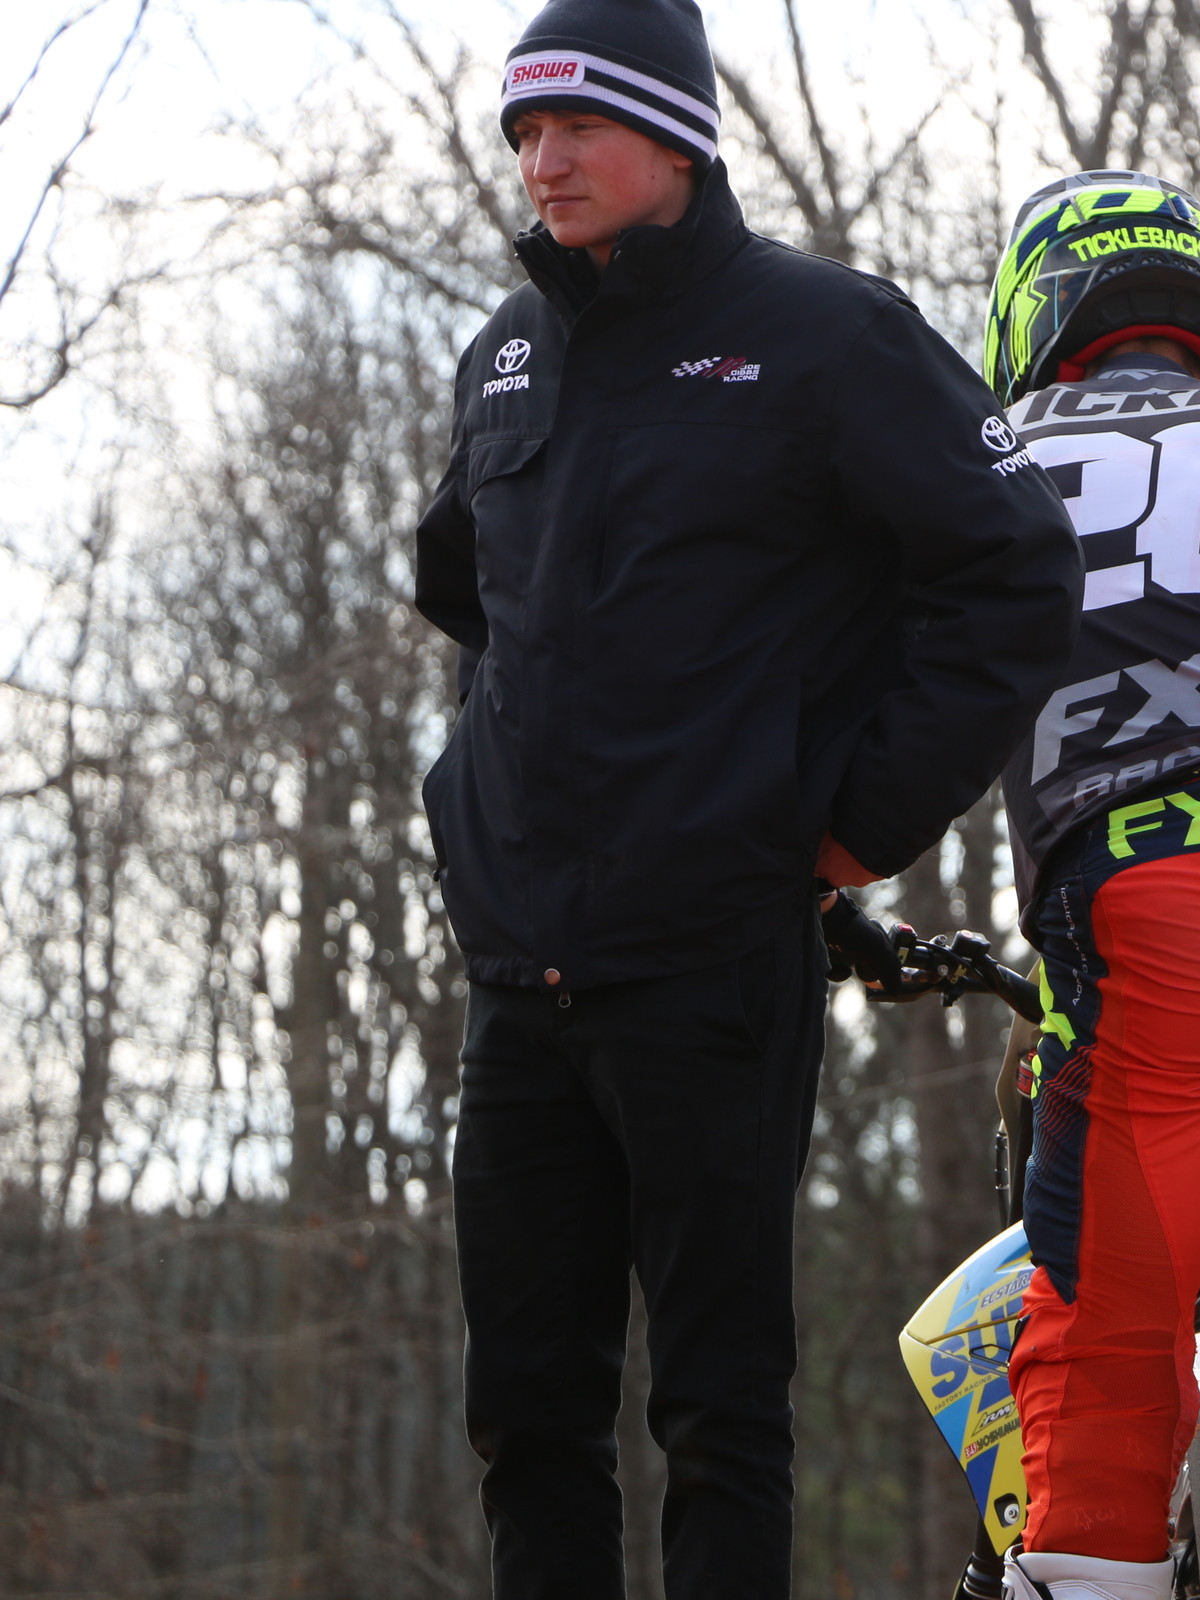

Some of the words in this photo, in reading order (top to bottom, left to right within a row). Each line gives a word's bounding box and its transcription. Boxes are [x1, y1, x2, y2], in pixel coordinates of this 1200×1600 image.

[512, 62, 578, 84] SHOWA
[482, 374, 529, 398] TOYOTA
[723, 374, 758, 382] RACING
[991, 448, 1038, 477] TOYOT
[981, 1272, 1031, 1309] ECSTAR
